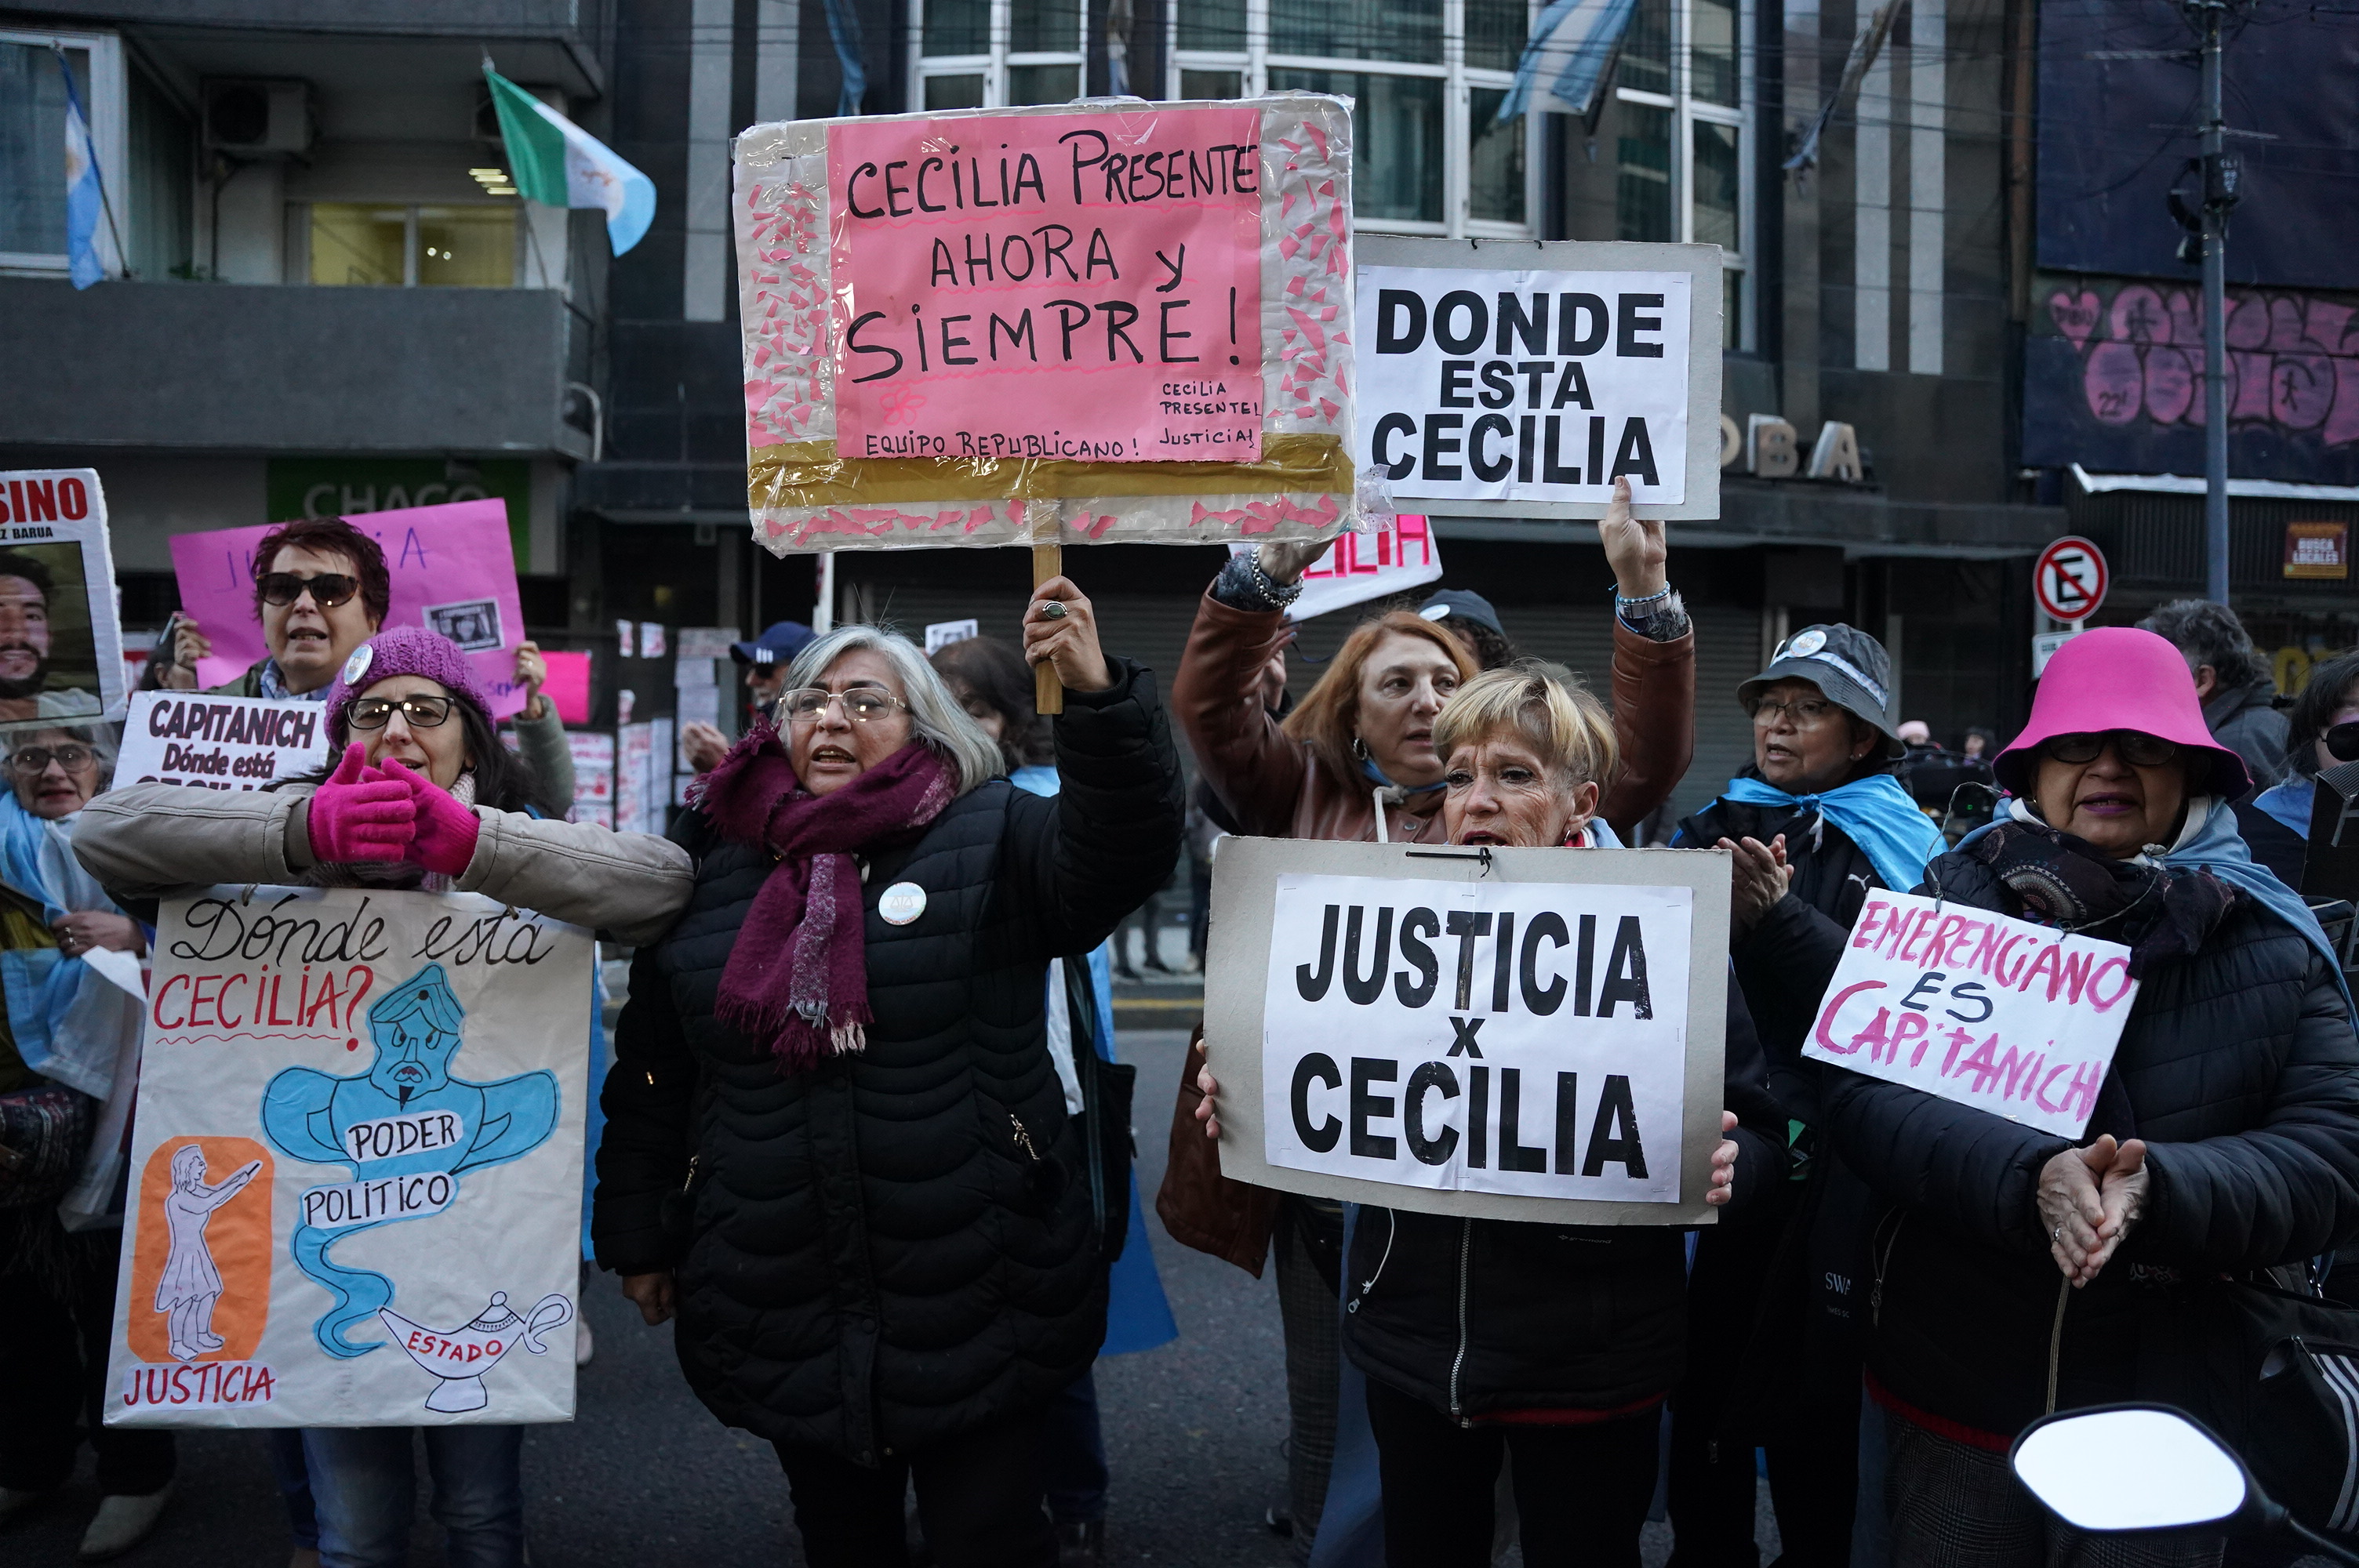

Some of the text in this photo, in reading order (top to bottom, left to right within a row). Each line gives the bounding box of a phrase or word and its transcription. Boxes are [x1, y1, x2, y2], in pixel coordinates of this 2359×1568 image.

[931, 224, 1119, 287] AHORA
[1376, 289, 1664, 358] DONDE
[1440, 361, 1594, 410] ESTA
[1372, 412, 1660, 486] CECILIA
[13, 527, 53, 539] BARUA
[1303, 514, 1430, 579] ILIA
[149, 699, 318, 749] CAPITANICH
[162, 742, 276, 779] Dónde está
[171, 894, 557, 967] Dónde está
[1296, 904, 1653, 1020] JUSTICIA
[1899, 972, 1994, 1023] ES
[349, 1114, 456, 1160] PODER
[1290, 1051, 1648, 1179] CECILIA
[407, 1330, 503, 1362] ESTADO
[124, 1363, 276, 1405] JUSTICIA
